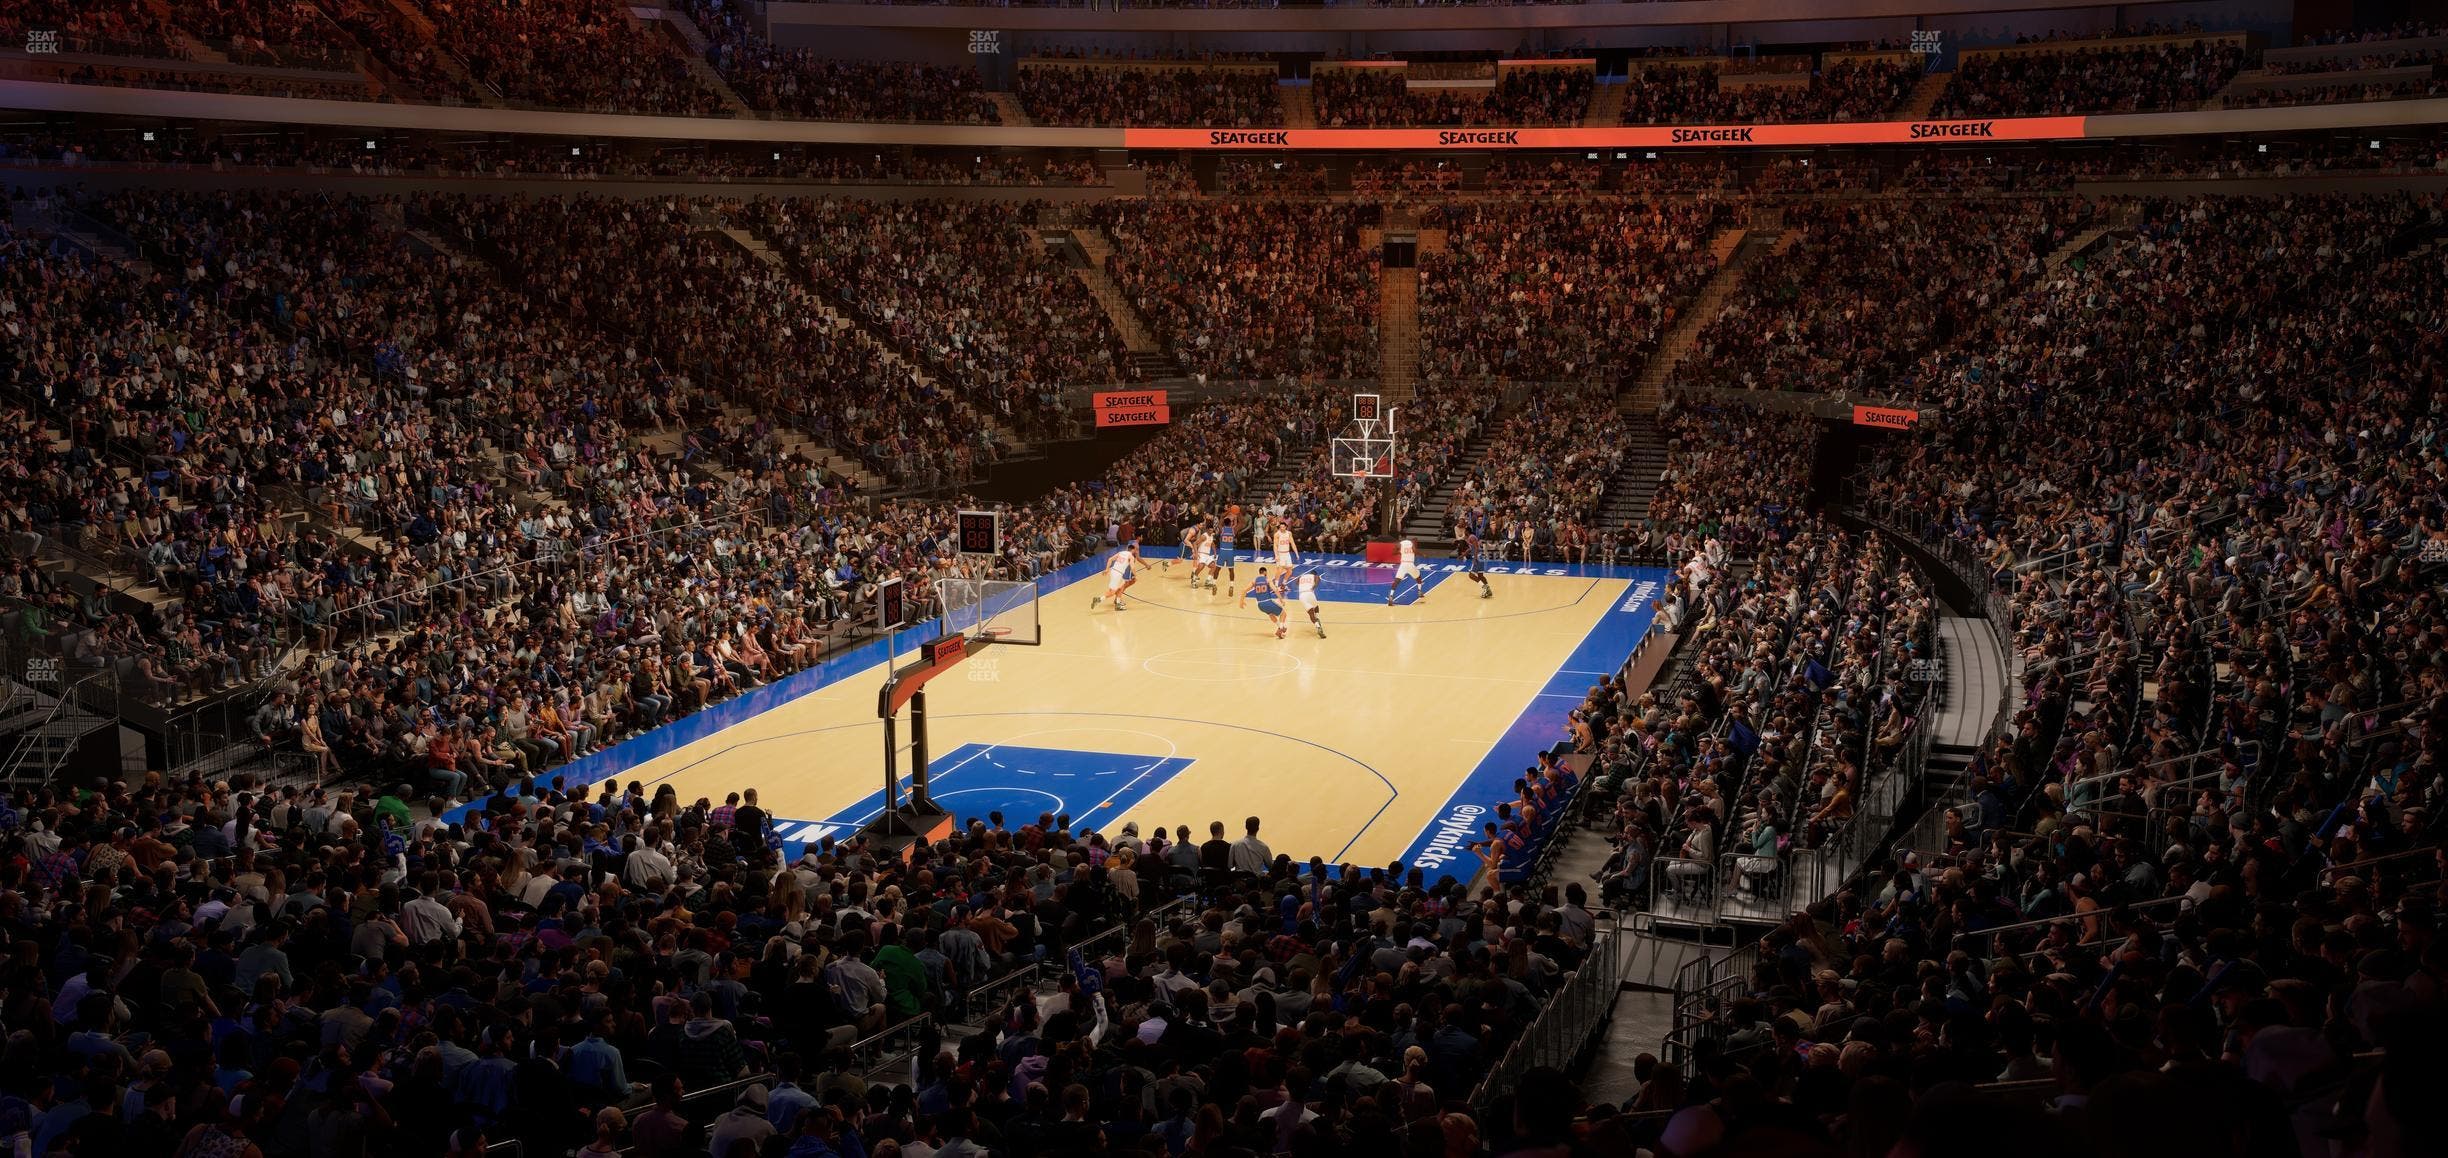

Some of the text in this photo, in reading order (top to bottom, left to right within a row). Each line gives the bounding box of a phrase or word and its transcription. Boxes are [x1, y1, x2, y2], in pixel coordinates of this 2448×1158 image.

[1671, 127, 1753, 143] SEATGEEK
[1910, 121, 1993, 138] SEATGEEK
[1210, 131, 1288, 145] SEATGEEK
[1439, 130, 1518, 145] SEATGEEK
[1105, 395, 1154, 407] SEATGEEK
[1108, 411, 1157, 424] SEATGEEK
[1865, 411, 1908, 427] SEATGEEK
[1415, 562, 1568, 576] KNCKS
[937, 641, 962, 659] SEATGEEK
[1413, 804, 1487, 870] @nyknicks
